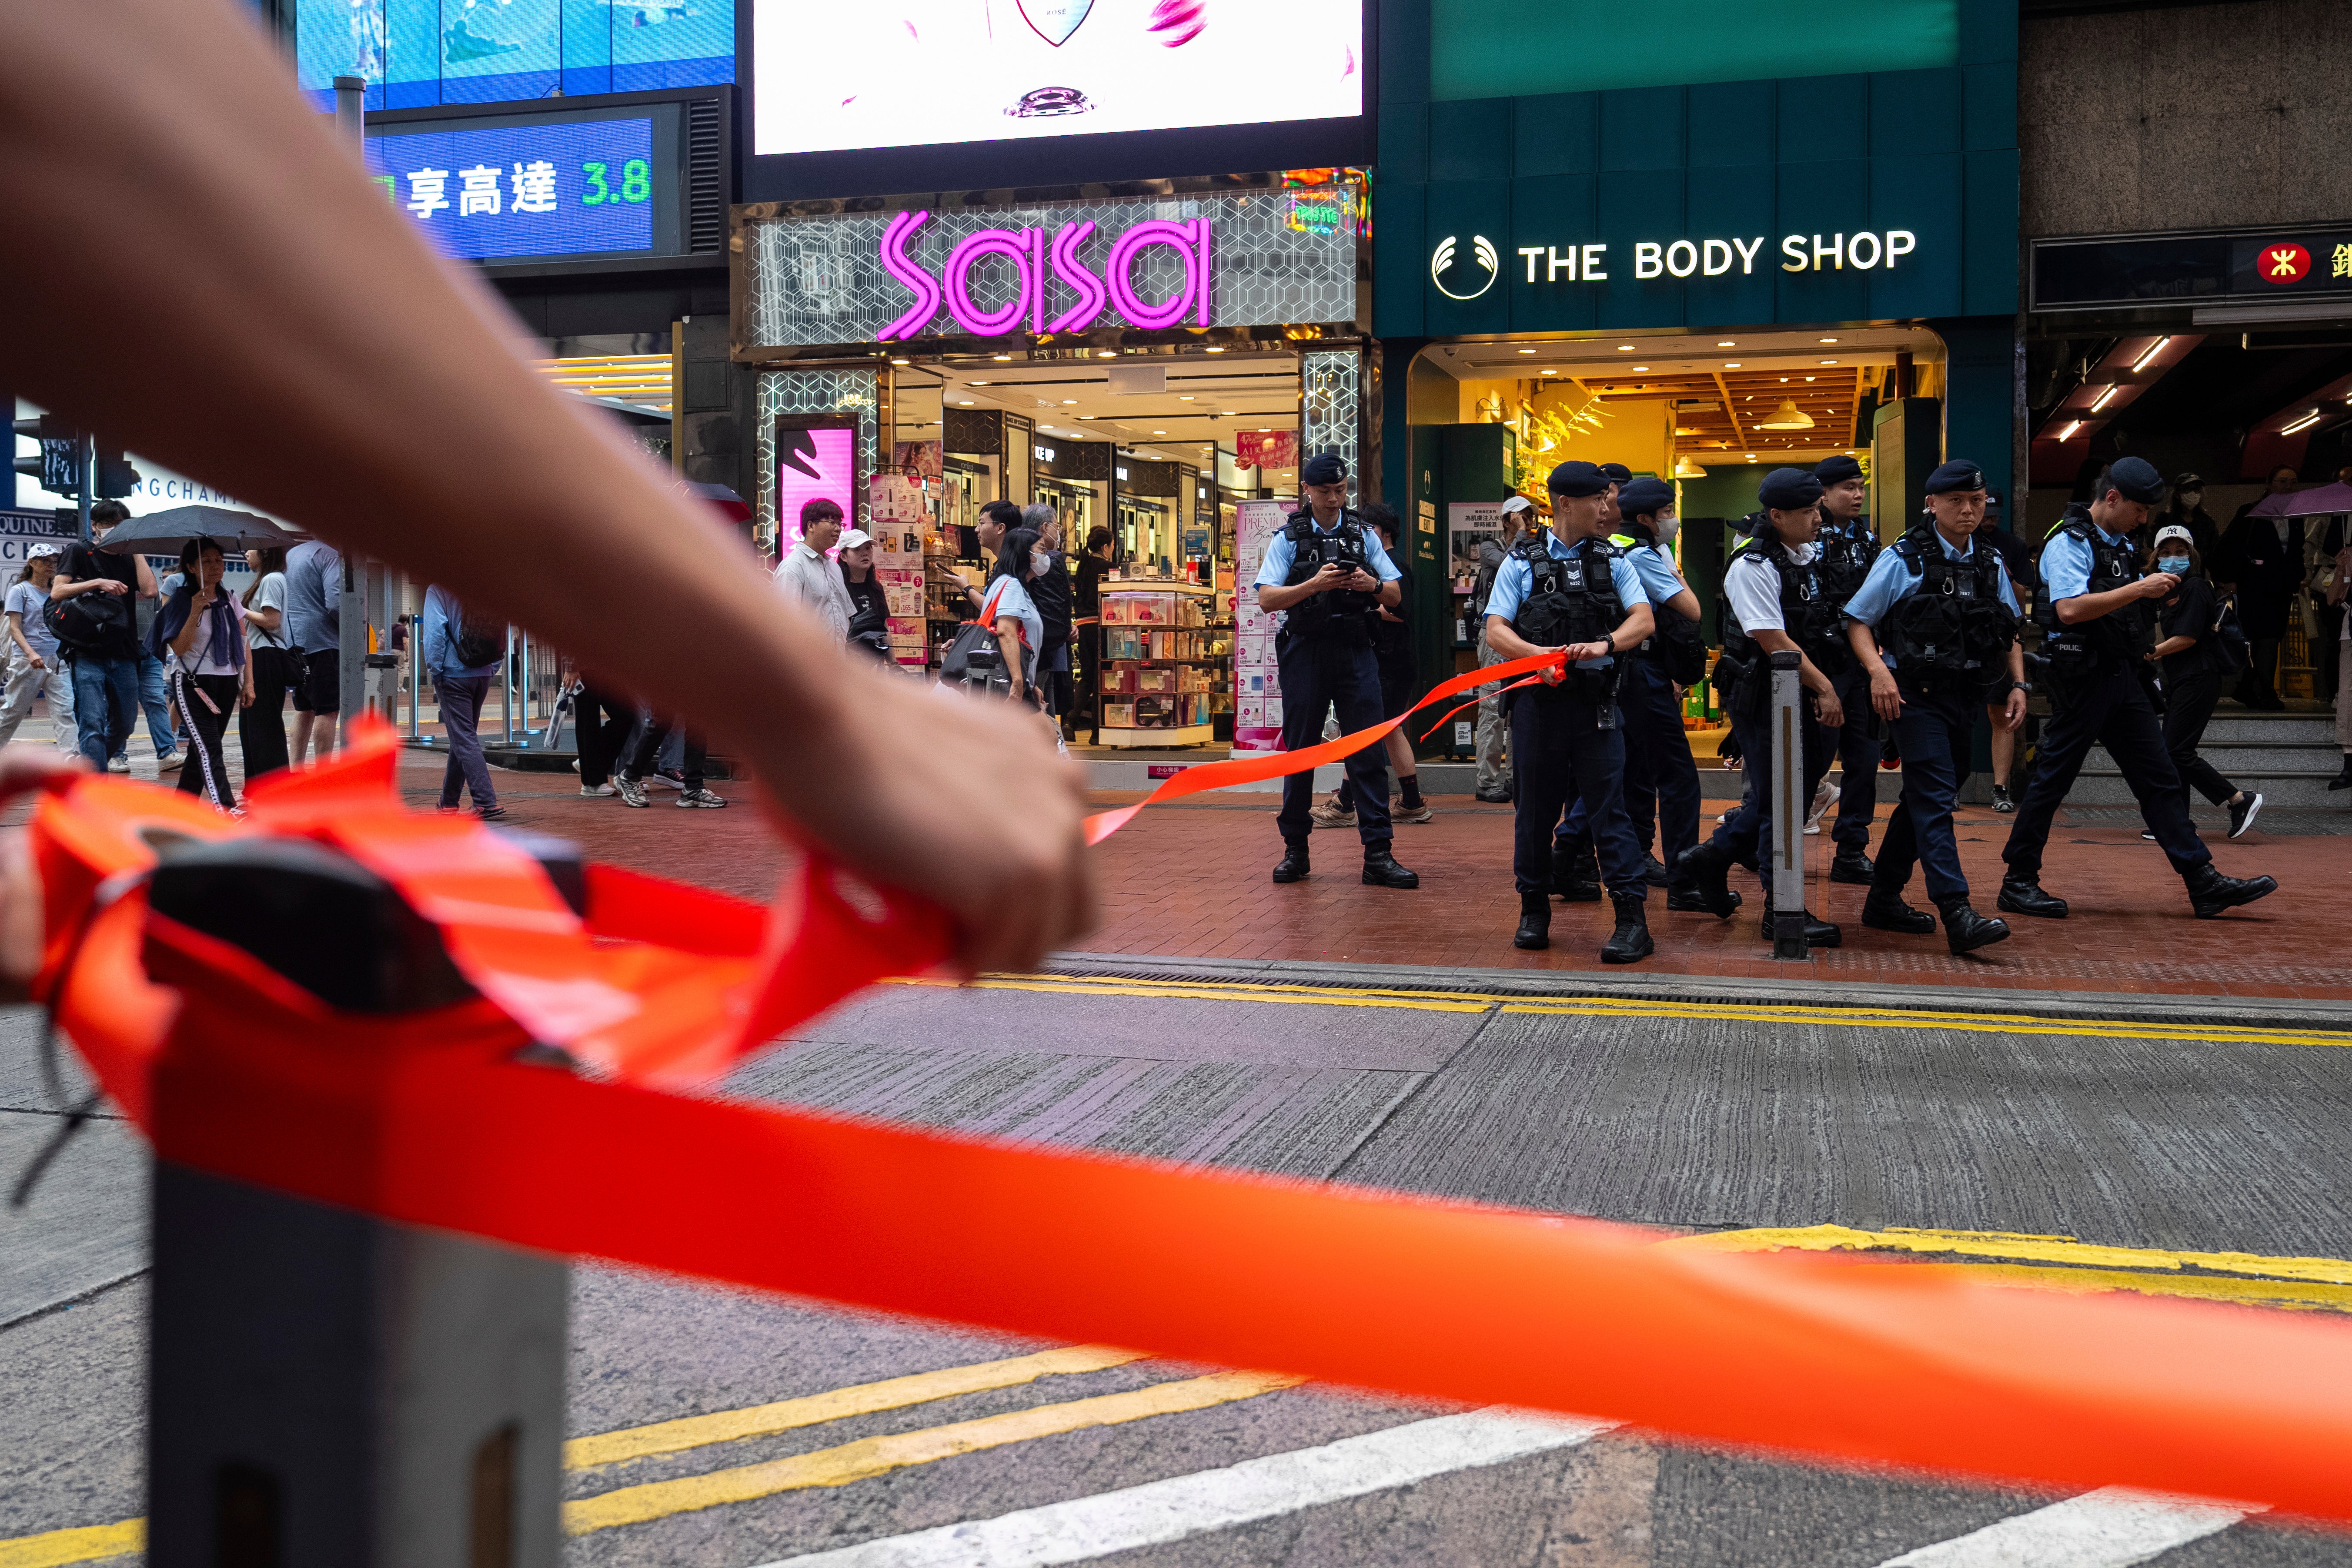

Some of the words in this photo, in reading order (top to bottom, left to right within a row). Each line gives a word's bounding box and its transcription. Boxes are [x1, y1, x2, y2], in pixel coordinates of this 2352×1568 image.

[407, 160, 558, 218] 享高達
[582, 158, 651, 205] 3.8
[1518, 244, 1607, 283] THE
[1635, 237, 1764, 279] BODY
[1781, 230, 1916, 272] SHOP
[1045, 448, 1055, 462] UP
[1894, 544, 1904, 553] 7857
[1267, 655, 1276, 664] 9折
